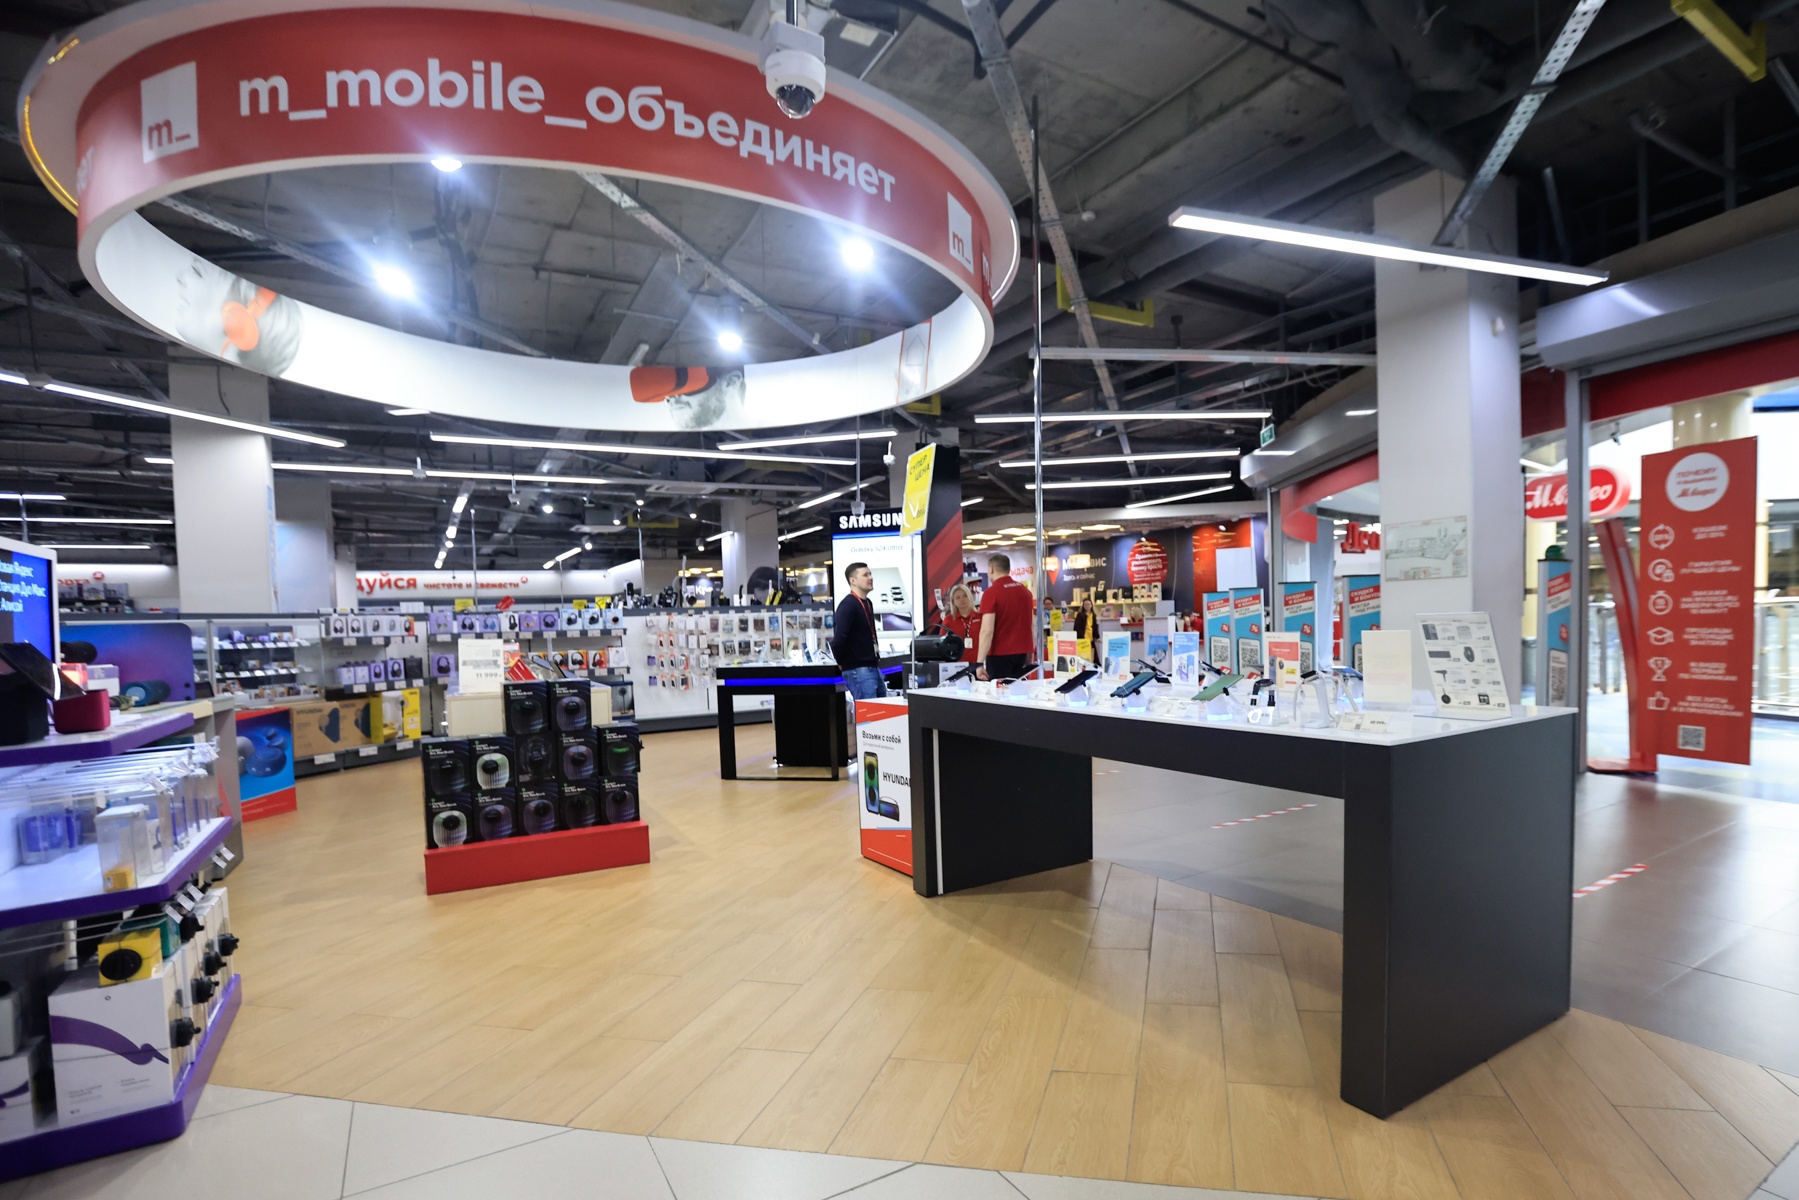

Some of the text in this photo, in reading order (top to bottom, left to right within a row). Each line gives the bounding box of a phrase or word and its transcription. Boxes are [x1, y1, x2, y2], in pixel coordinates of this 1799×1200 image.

[839, 512, 902, 530] SAMSUN
[1010, 566, 1034, 577] ыдача
[356, 573, 417, 594] дуйся
[862, 730, 881, 741] Возьми
[886, 734, 902, 744] собой
